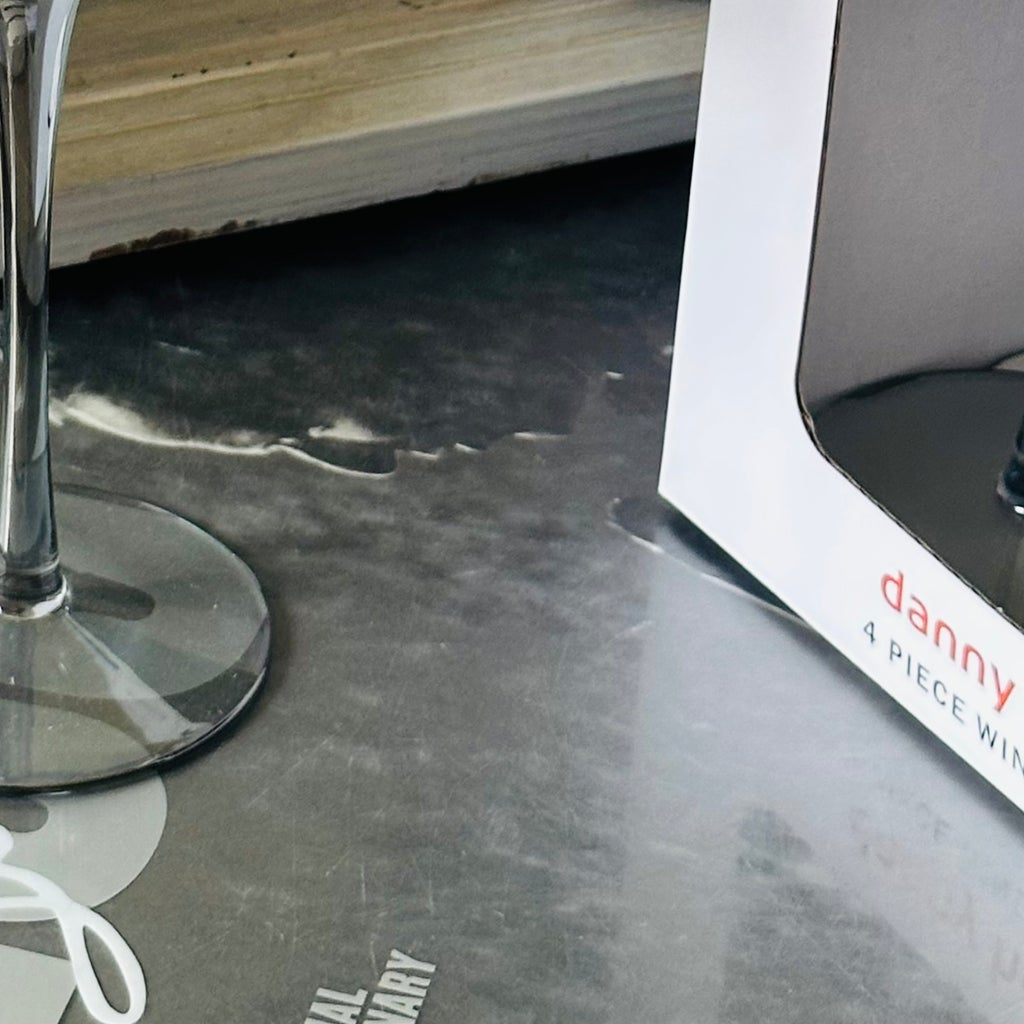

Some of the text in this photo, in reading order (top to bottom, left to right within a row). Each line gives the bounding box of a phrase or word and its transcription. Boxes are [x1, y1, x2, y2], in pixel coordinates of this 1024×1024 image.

[863, 621, 876, 644] 4
[888, 638, 966, 725] PIECE
[880, 569, 1016, 714] danny
